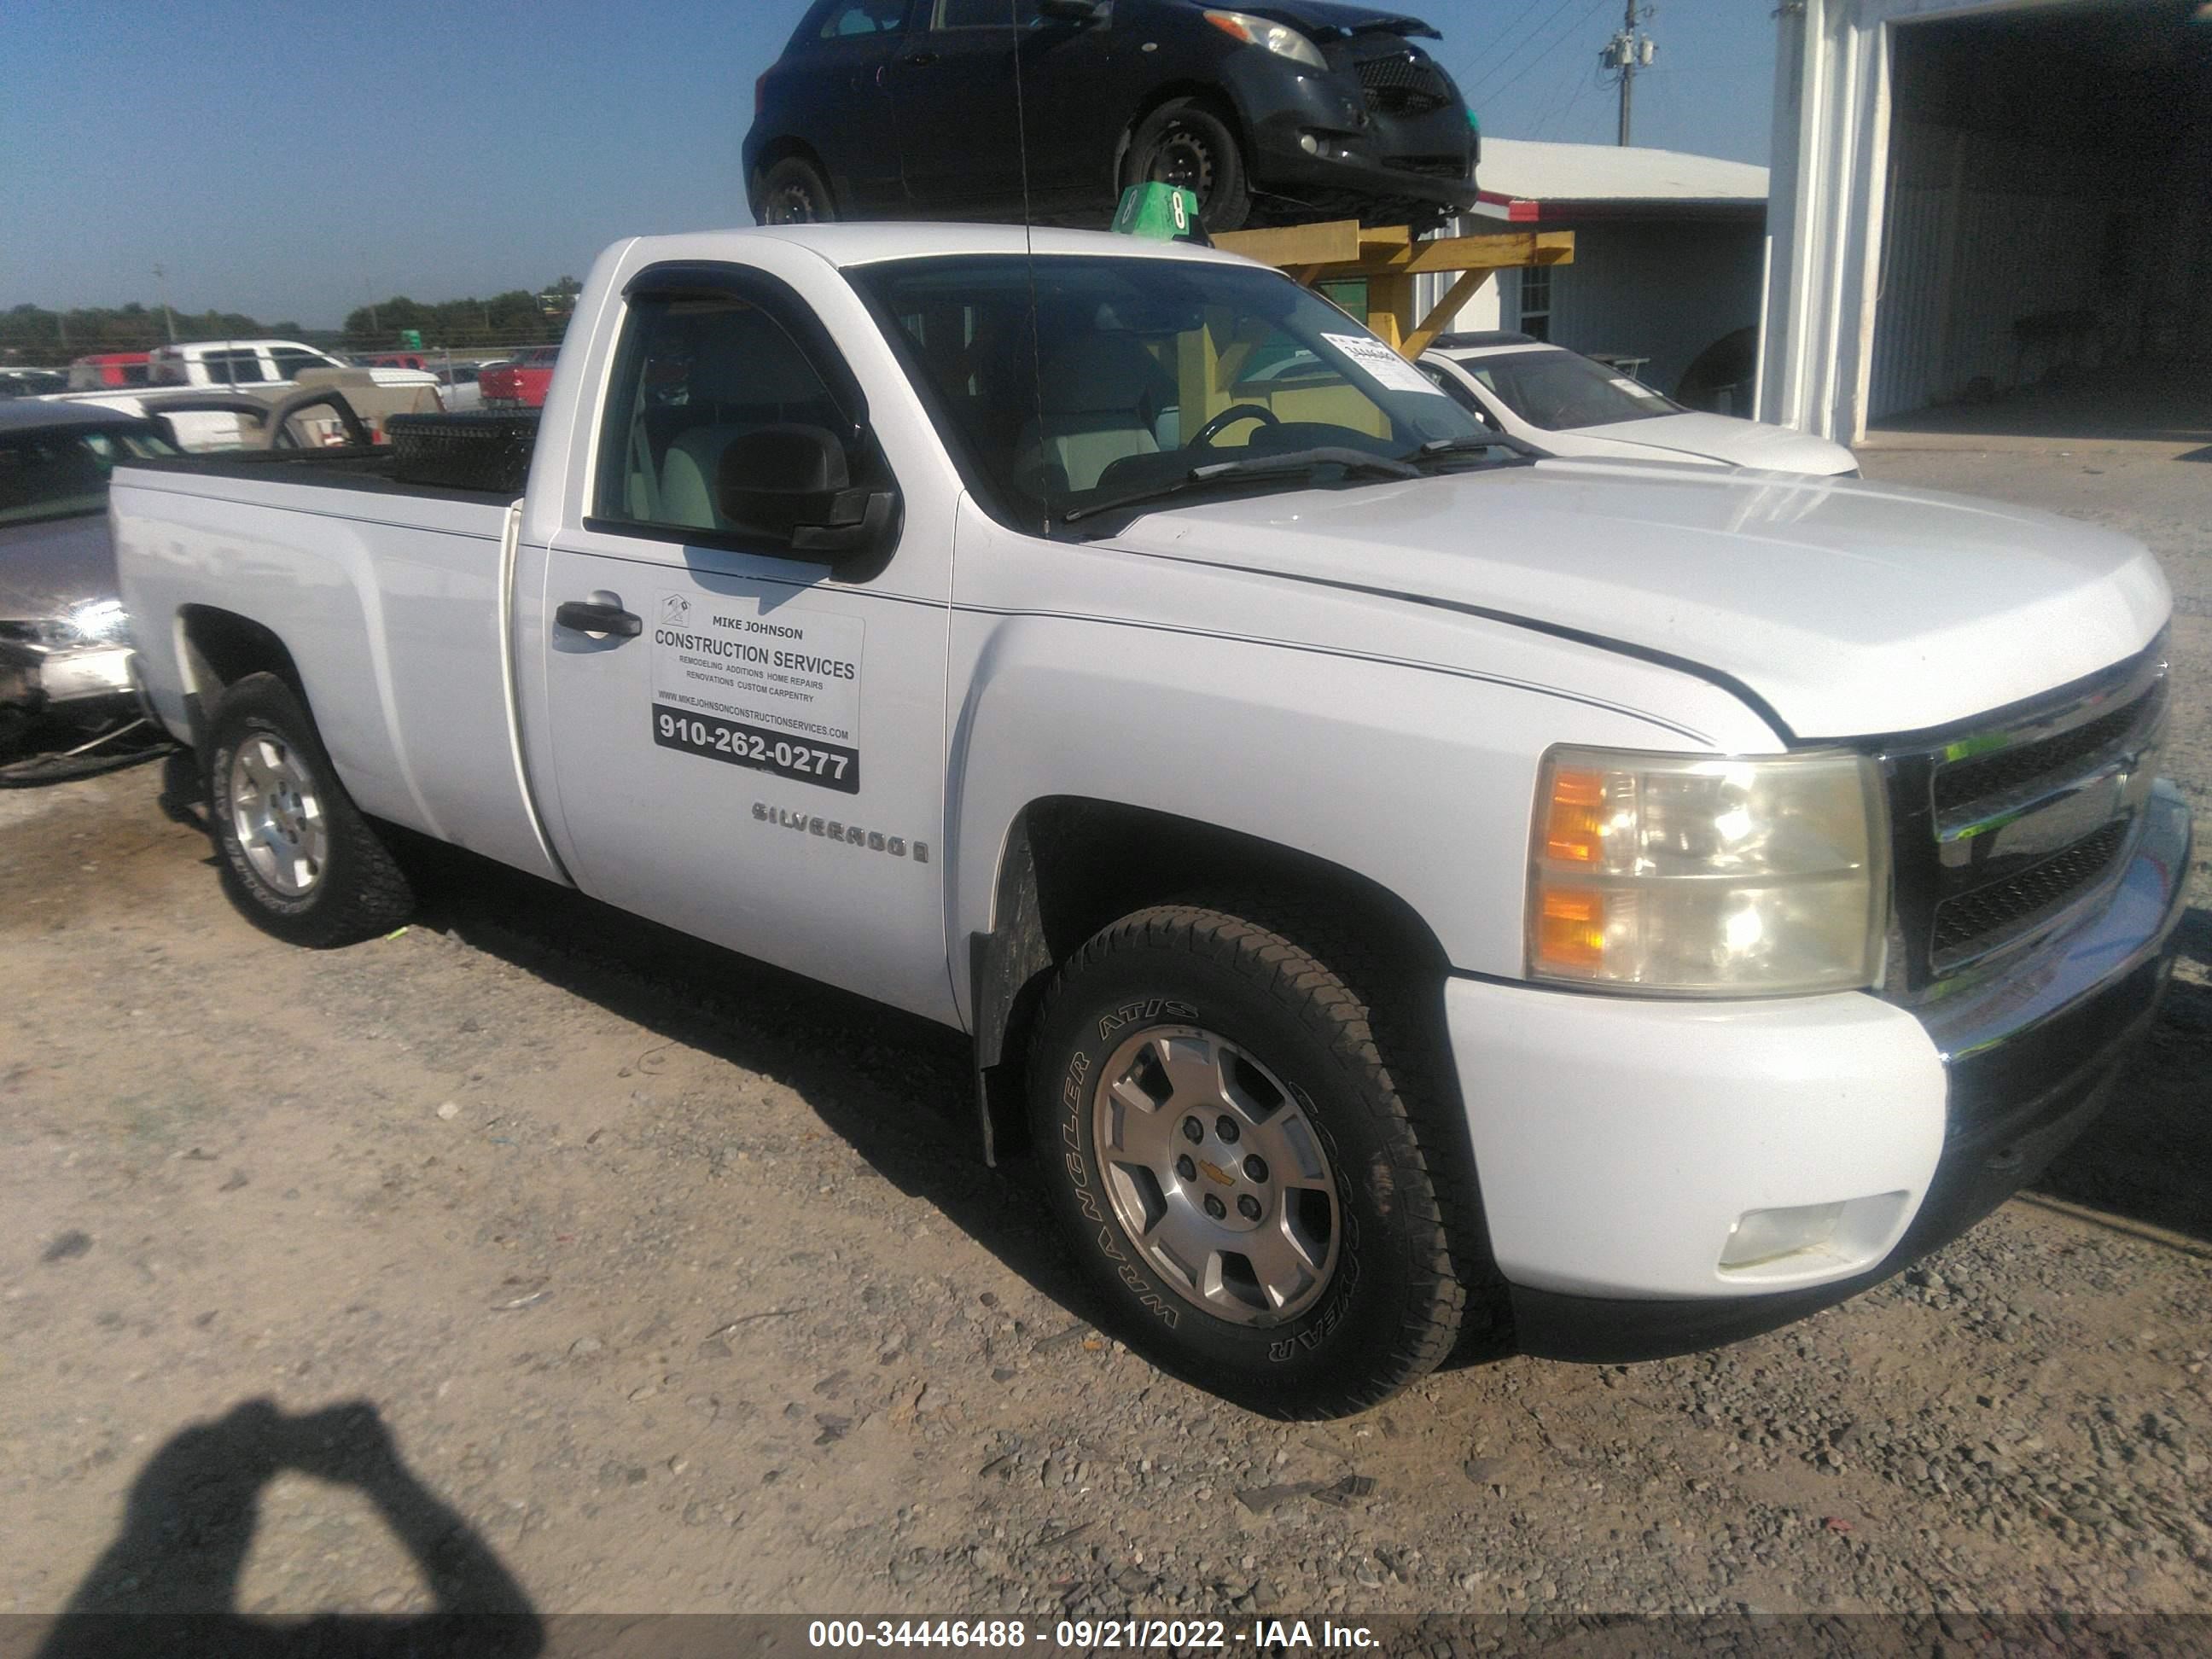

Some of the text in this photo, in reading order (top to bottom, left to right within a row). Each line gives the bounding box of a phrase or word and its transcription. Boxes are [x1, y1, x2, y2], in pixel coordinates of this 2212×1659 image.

[1173, 191, 1185, 230] 8
[713, 615, 803, 639] MIKE JOHNSON
[655, 630, 854, 679] CONSTRUCTION SERVICES
[679, 655, 824, 690] REMODELING ADDITIONS HOME REPAIRS
[686, 671, 814, 703] RENOVATIONS CUSTOM CARPENTRY
[658, 690, 849, 740] WWW.MIKEJOHNSONCONSTRUCTIONSERVICES.COM
[659, 713, 849, 780] 910-262-0277
[751, 801, 907, 857] SILVERADO
[1062, 1051, 1179, 1330] WRANGLER
